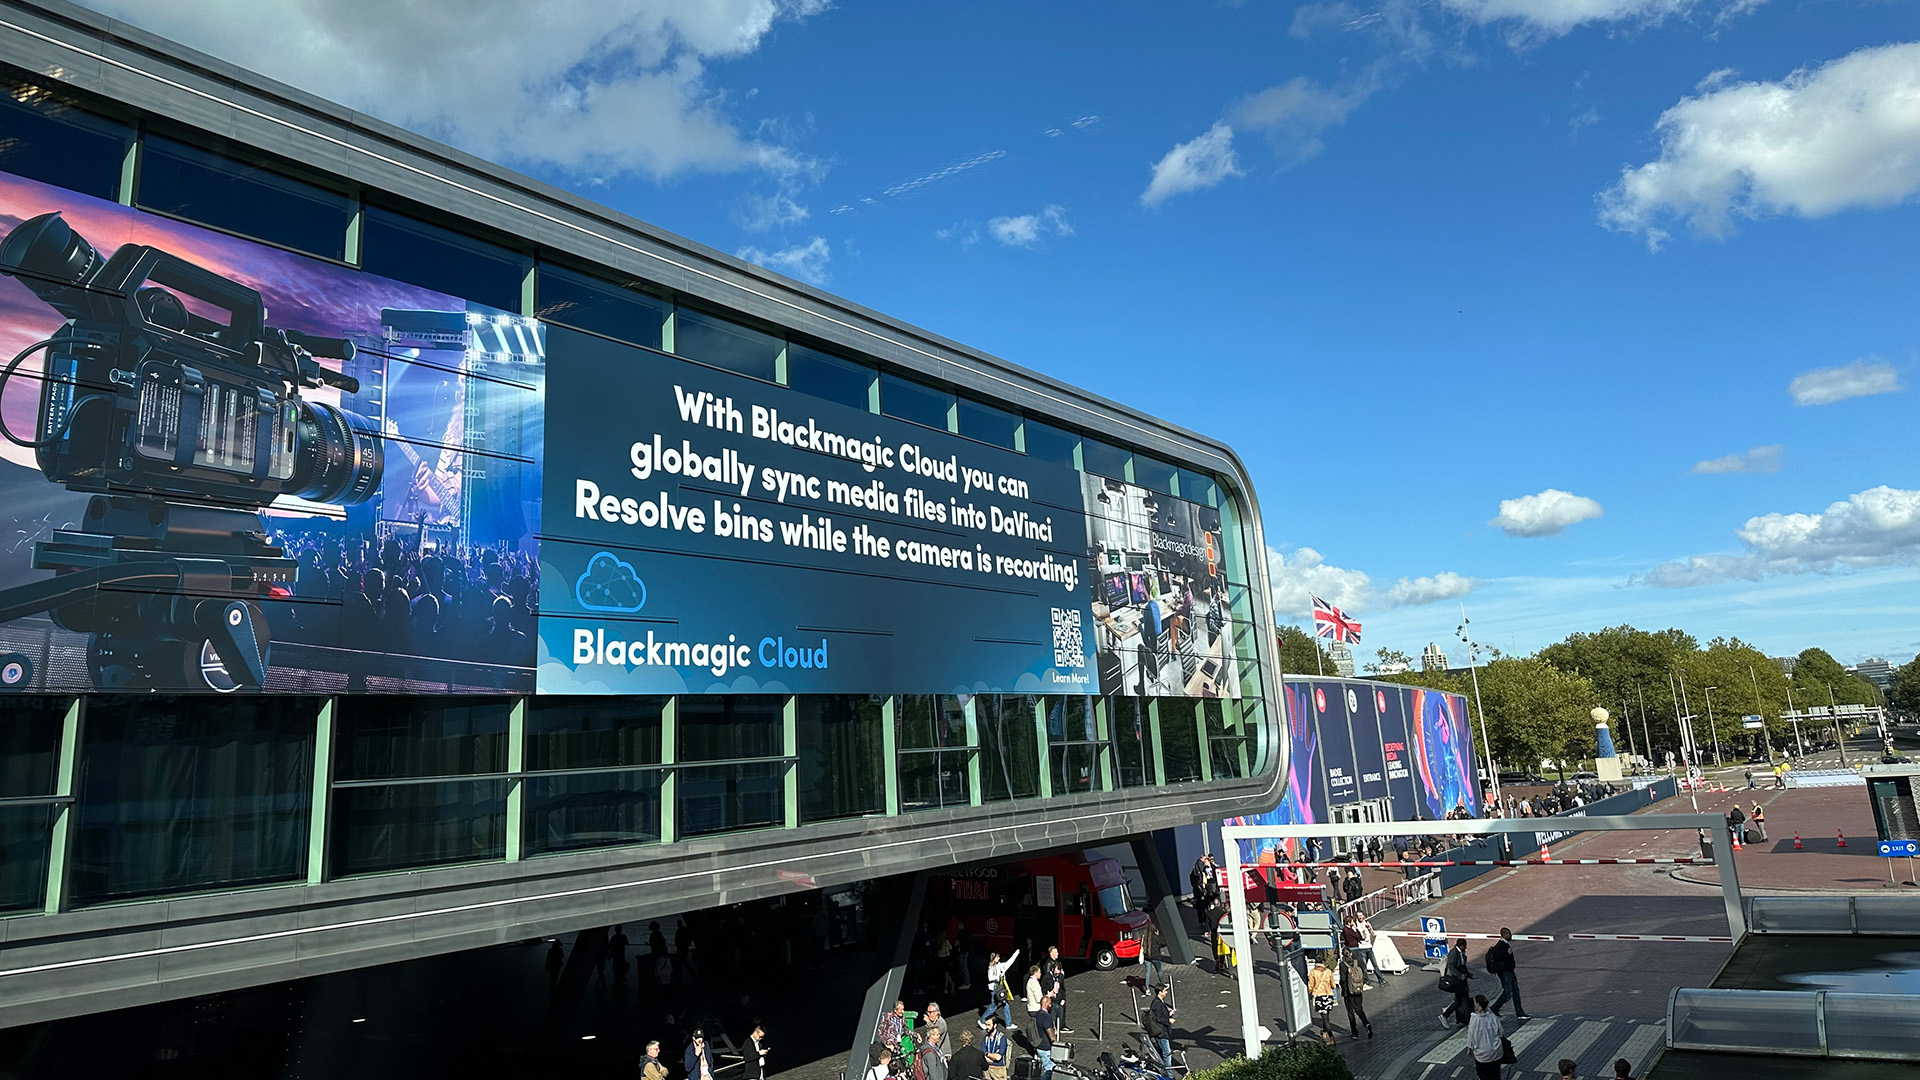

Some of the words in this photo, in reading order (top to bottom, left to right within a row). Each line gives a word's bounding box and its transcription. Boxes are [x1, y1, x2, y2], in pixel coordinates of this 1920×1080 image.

[47, 402, 56, 434] BATTERY
[363, 448, 373, 459] 45
[673, 385, 744, 434] With
[751, 405, 895, 473] Blackmagic
[898, 444, 958, 484] Cloud
[960, 464, 996, 494] you
[997, 475, 1029, 501] can
[630, 433, 756, 497] globally
[761, 466, 821, 503] sync
[827, 478, 899, 515] media
[904, 490, 947, 525] files
[950, 502, 986, 530] into
[990, 507, 1052, 544] DaVinci
[575, 479, 706, 534] Resolve
[714, 499, 774, 543] bins
[779, 515, 848, 553] while
[851, 524, 891, 560] the
[895, 540, 973, 571] camera
[976, 549, 993, 574] is
[995, 555, 1079, 592] recording!
[573, 628, 751, 677] Blackmagic
[757, 638, 829, 670] Cloud
[1052, 672, 1070, 683] Learn
[1071, 672, 1090, 684] More!
